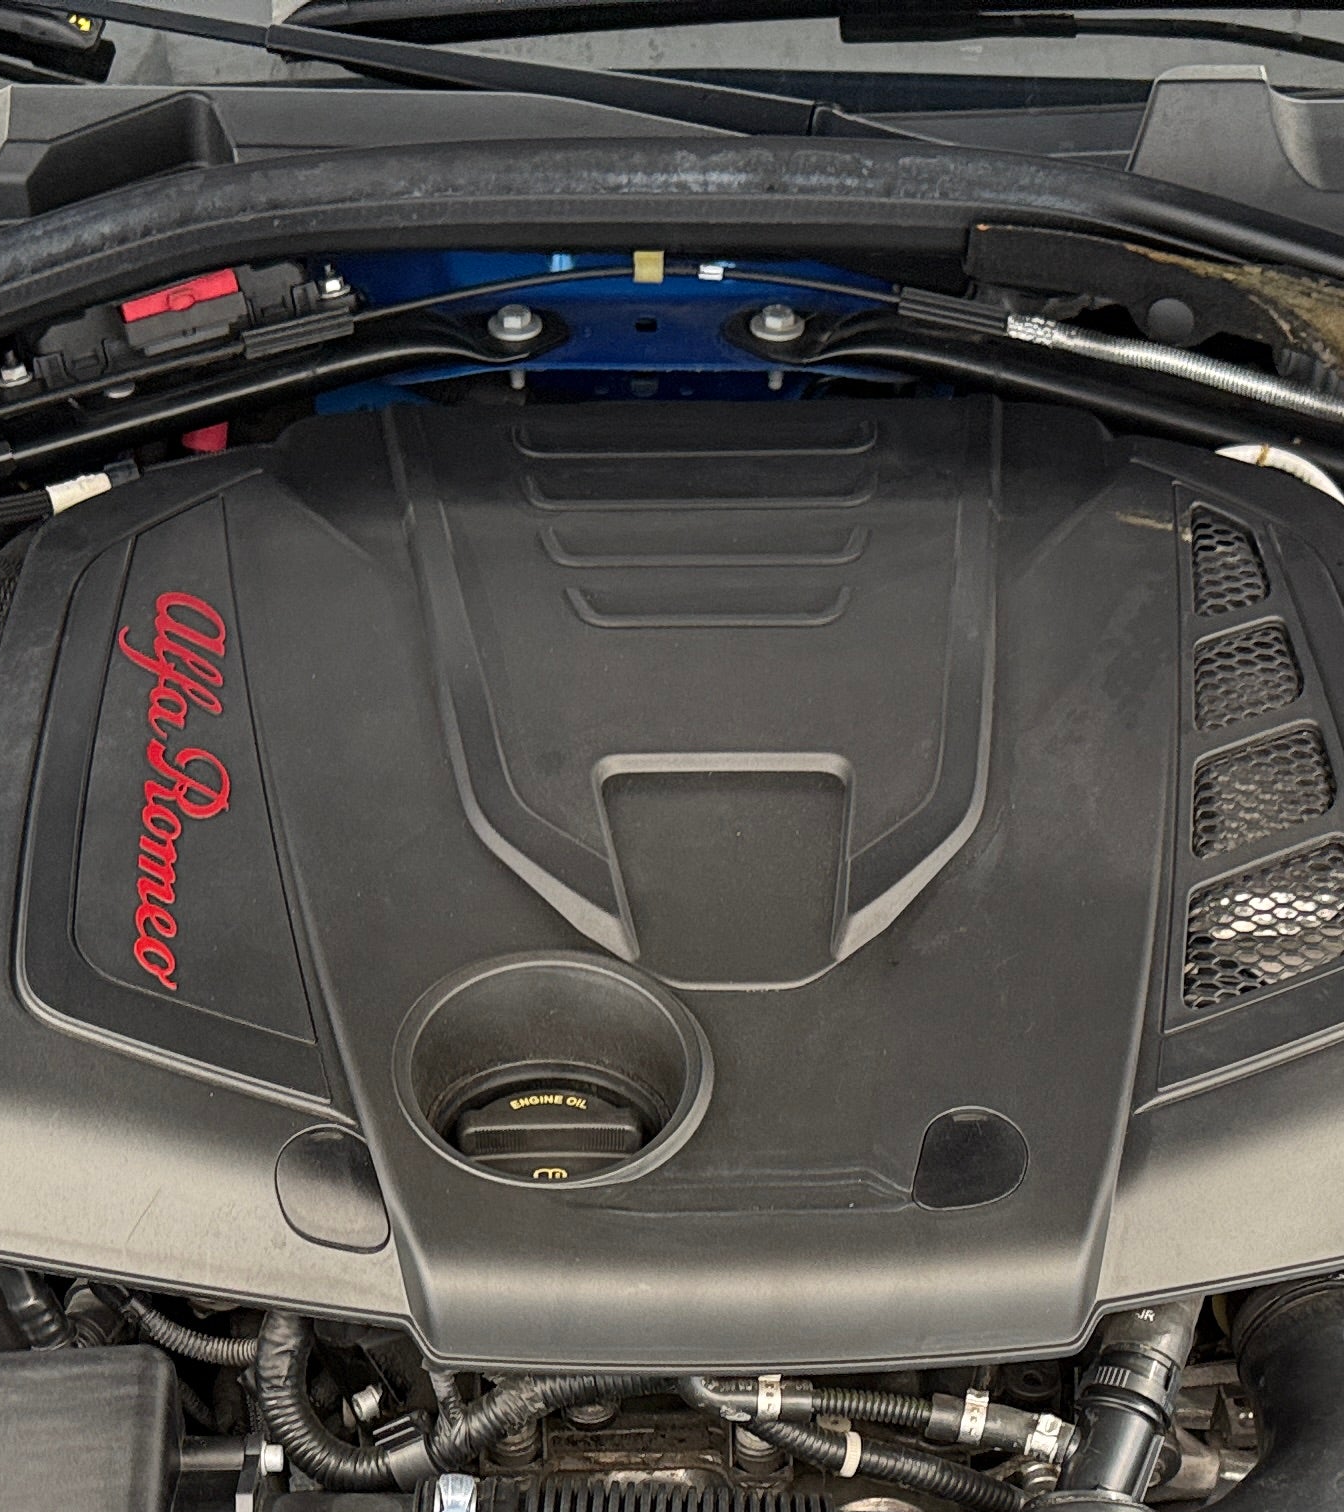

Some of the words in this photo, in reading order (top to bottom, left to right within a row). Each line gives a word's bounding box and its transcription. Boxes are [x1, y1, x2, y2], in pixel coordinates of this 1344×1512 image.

[118, 592, 226, 740] Alfa
[134, 738, 231, 990] Romeo
[510, 1095, 563, 1110] ENGINE
[566, 1097, 587, 1110] OIL
